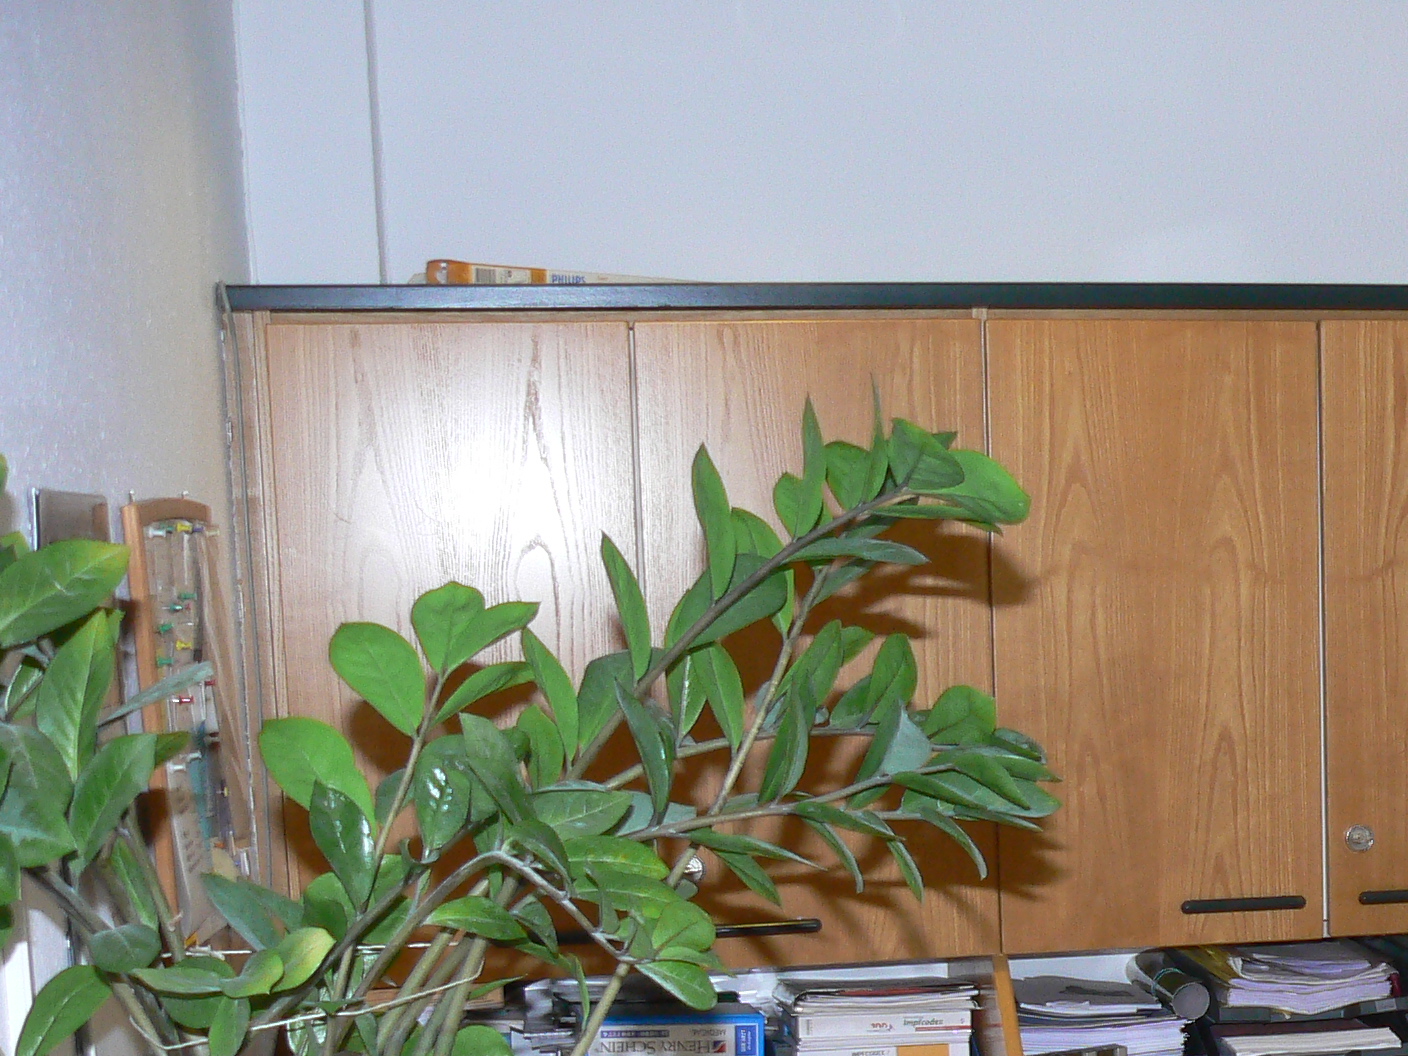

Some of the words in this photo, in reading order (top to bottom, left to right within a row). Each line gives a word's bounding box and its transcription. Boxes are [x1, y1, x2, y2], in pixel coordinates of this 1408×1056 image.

[552, 273, 587, 285] PHILIPS
[601, 1039, 656, 1055] SCHEIN
[661, 1040, 710, 1054] HENRY
